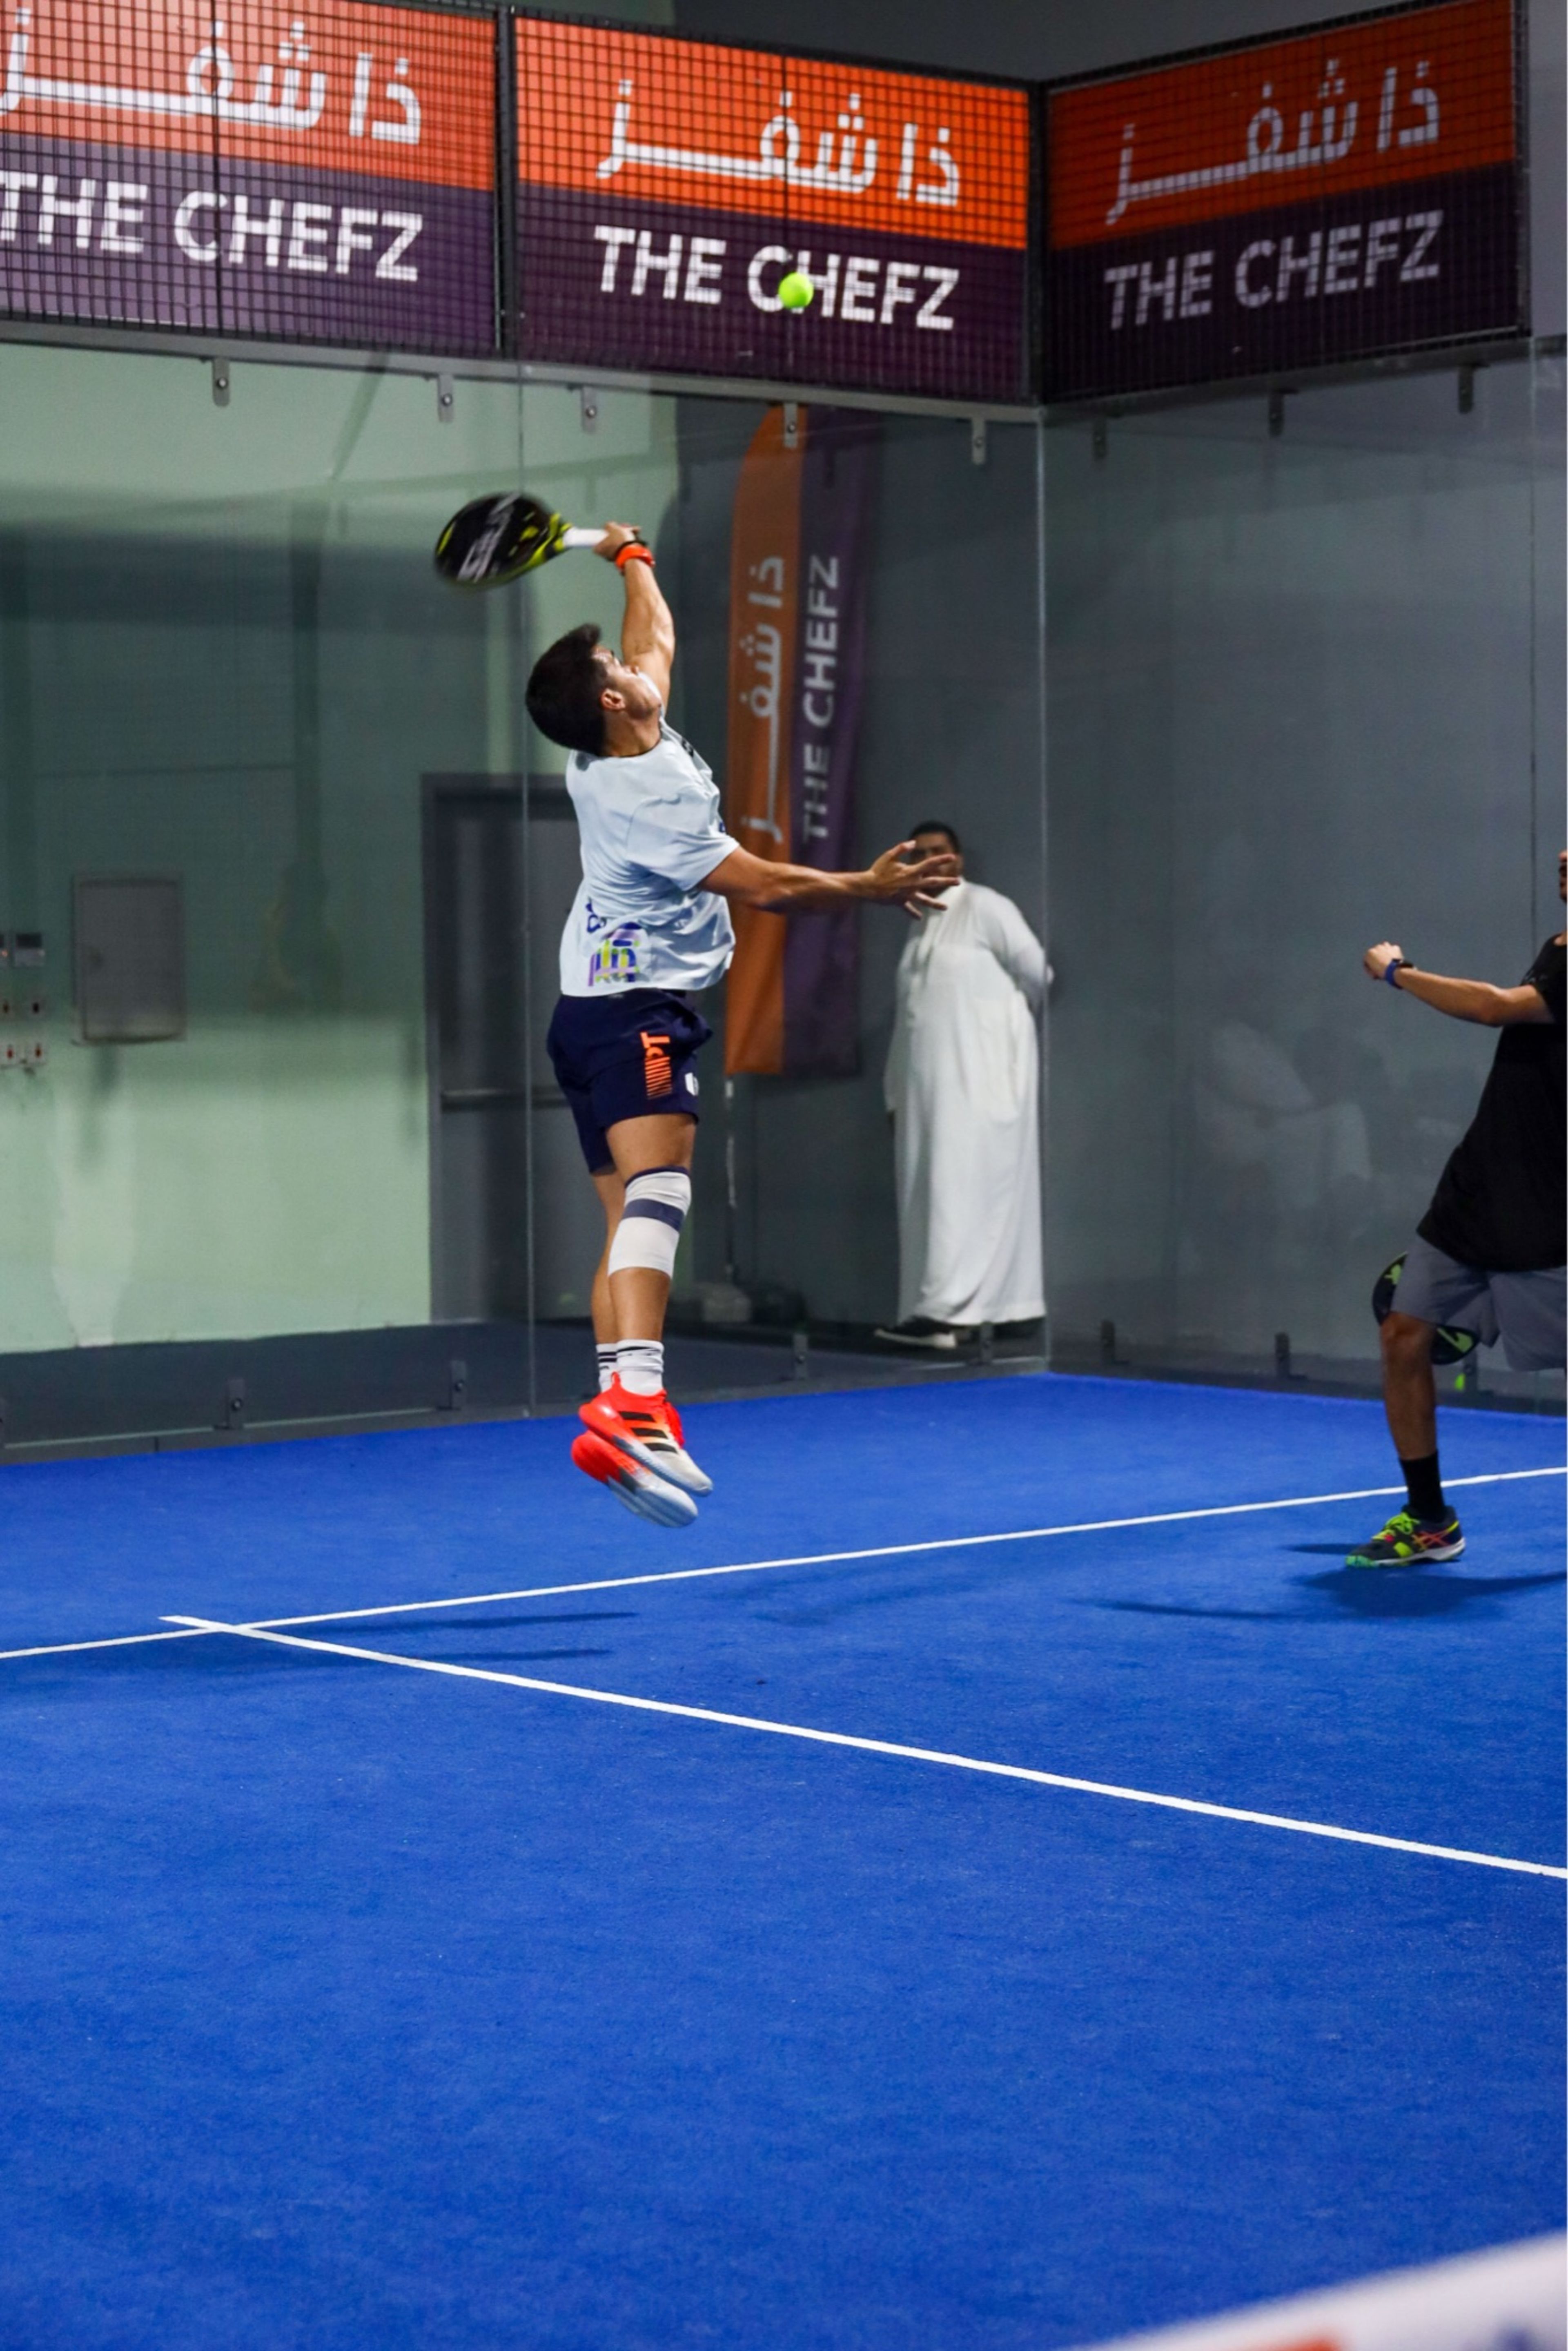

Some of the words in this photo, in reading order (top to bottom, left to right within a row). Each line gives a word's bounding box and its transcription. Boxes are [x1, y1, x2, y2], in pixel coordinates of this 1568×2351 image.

[0, 170, 147, 252] THE
[174, 190, 422, 282] CHEFZ
[595, 225, 726, 304] THE
[748, 245, 959, 330] CHEFZ
[1104, 252, 1214, 329] THE
[1235, 210, 1443, 308] CHEFZ
[802, 555, 838, 728] CHEFZ
[802, 742, 831, 844] THE
